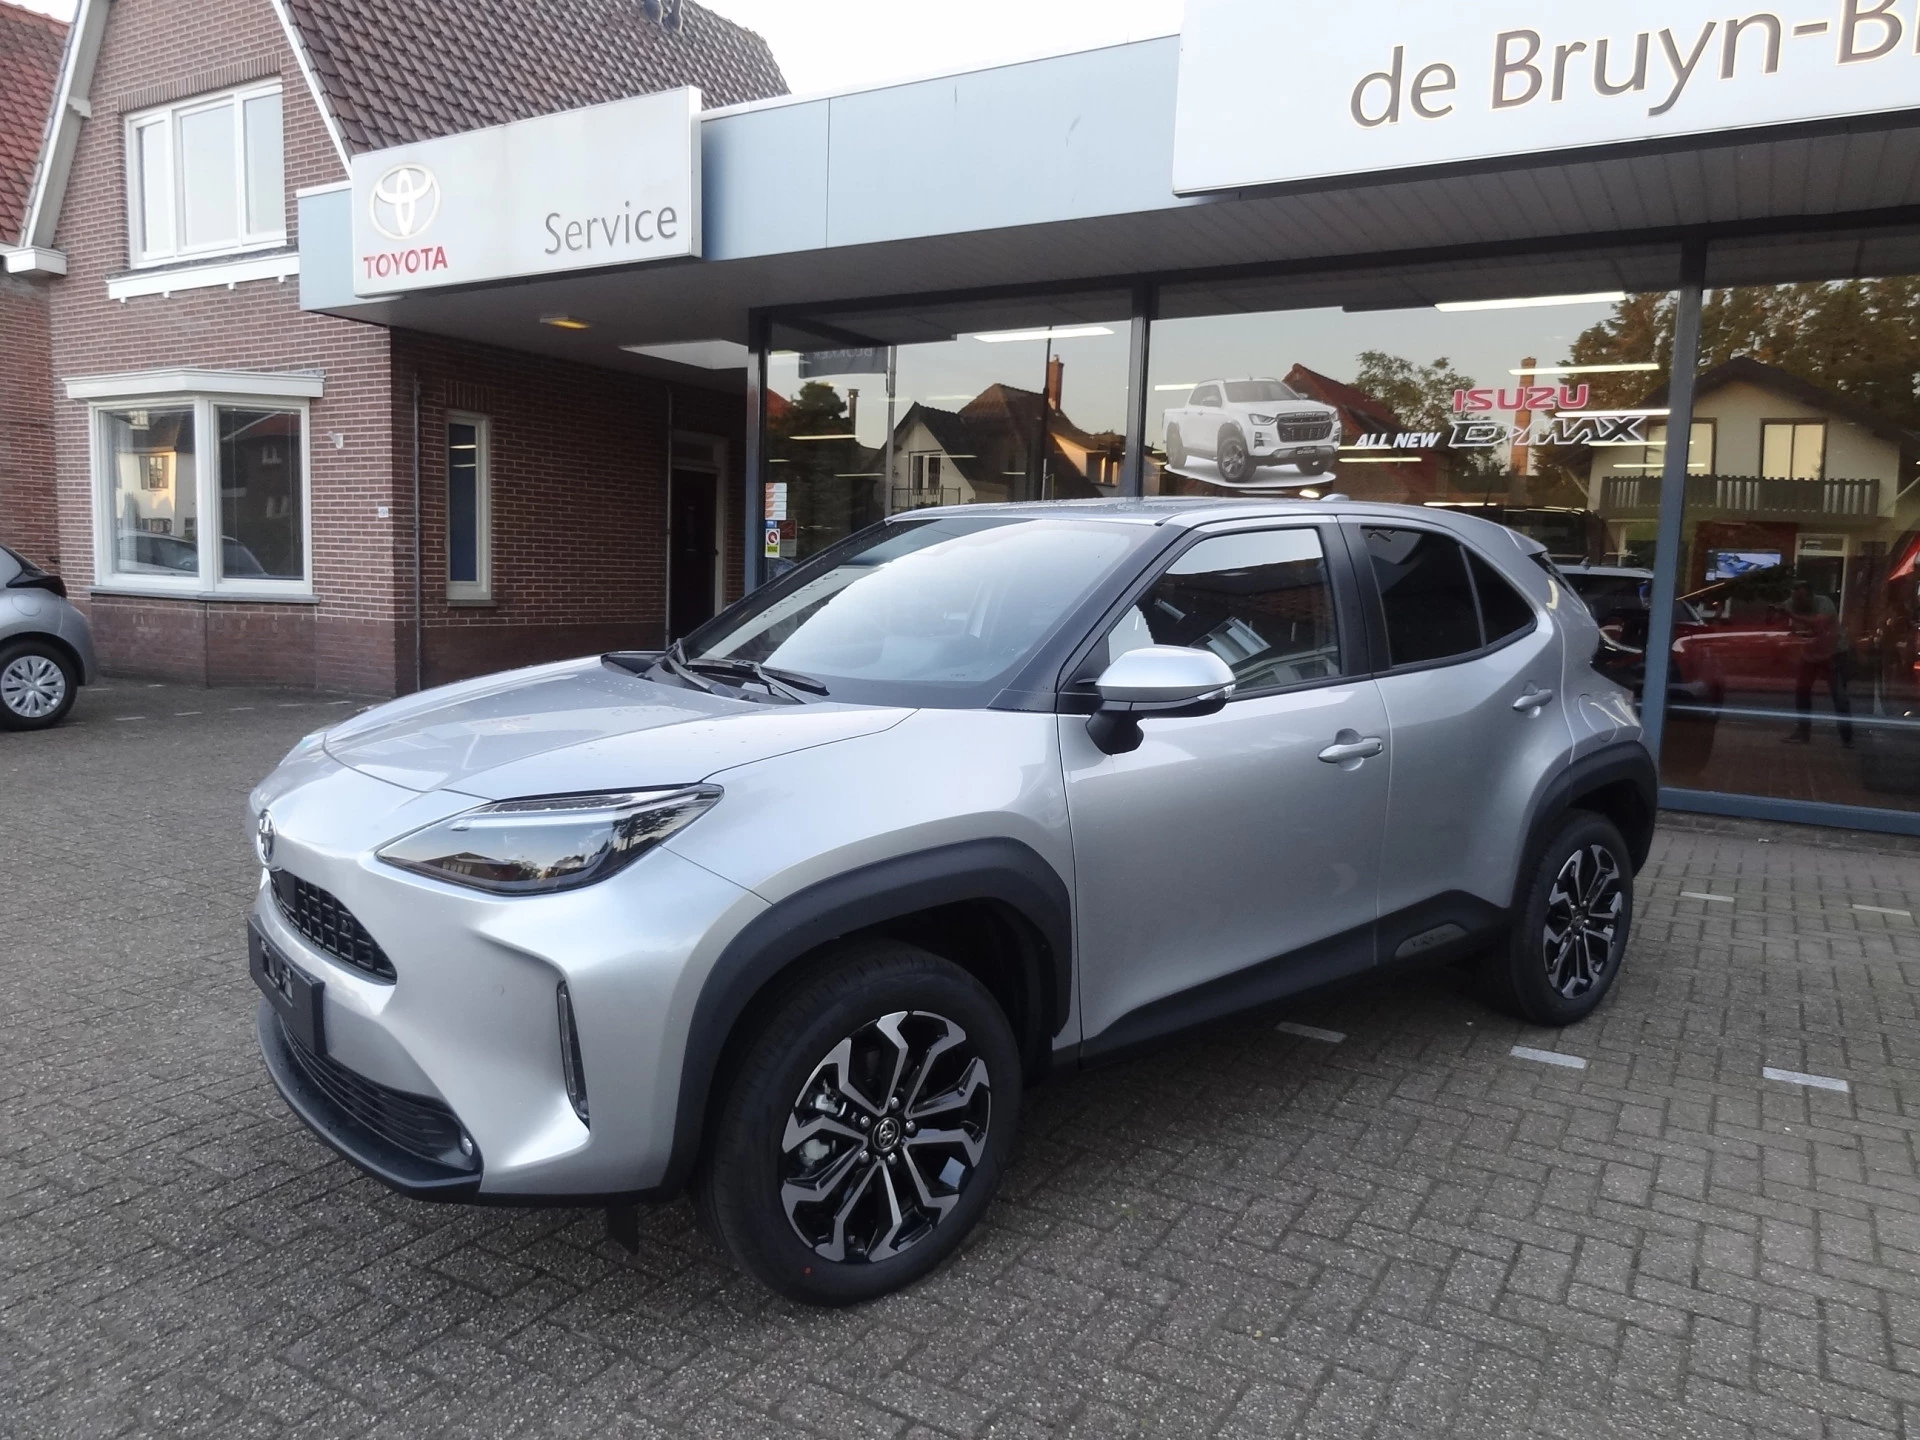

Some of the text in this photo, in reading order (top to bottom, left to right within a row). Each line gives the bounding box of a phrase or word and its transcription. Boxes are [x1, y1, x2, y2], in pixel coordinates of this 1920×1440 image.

[1350, 45, 1456, 128] de
[544, 200, 677, 254] Service
[362, 246, 448, 279] TOYOTA
[1453, 384, 1589, 412] ISUZU
[1355, 433, 1390, 447] ALL
[1392, 431, 1441, 448] NEW
